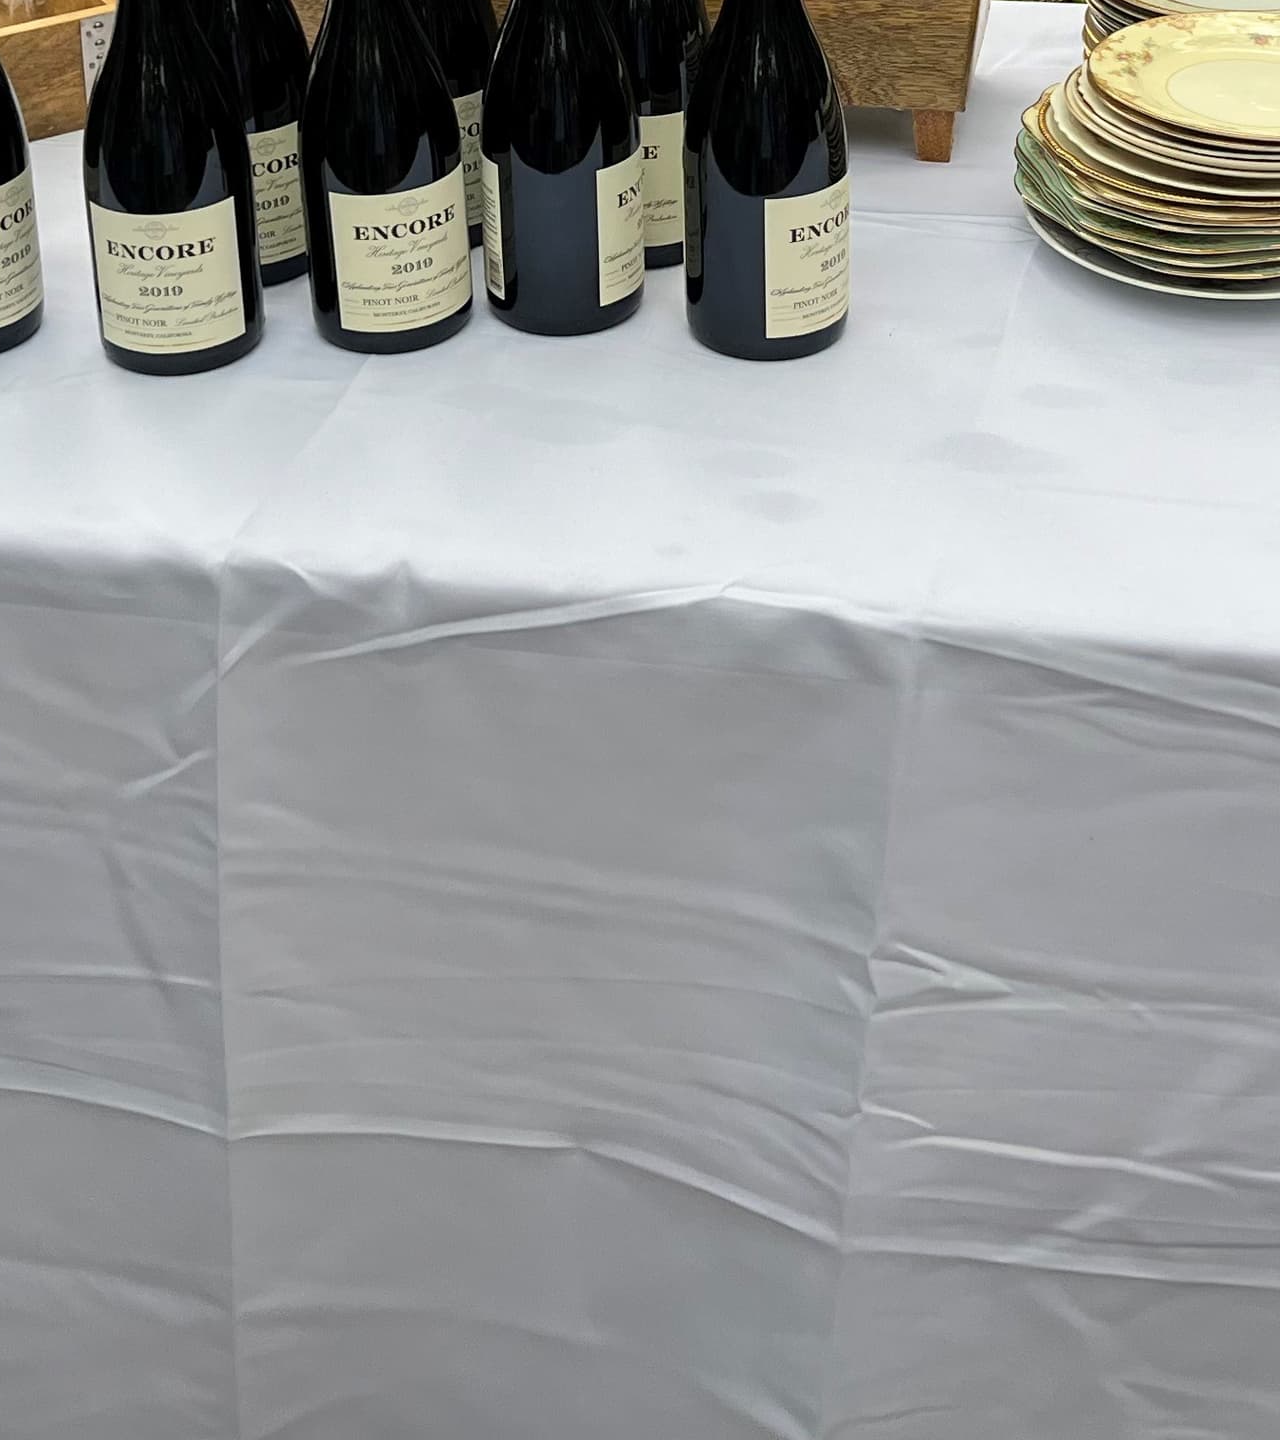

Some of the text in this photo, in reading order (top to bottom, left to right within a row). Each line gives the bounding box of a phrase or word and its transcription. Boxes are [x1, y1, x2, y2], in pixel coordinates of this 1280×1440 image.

[252, 153, 298, 177] COR
[352, 203, 455, 241] ENCORE
[789, 203, 849, 244] ENCO
[259, 230, 276, 239] OIR
[1, 244, 31, 269] 2019
[106, 237, 215, 261] ENCORE
[391, 257, 434, 275] 2019
[821, 248, 847, 273] 2019
[5, 283, 25, 298] NOIR
[138, 285, 184, 297] 2019
[362, 294, 420, 307] PINOT NOIR
[793, 297, 820, 310] PINOT
[116, 313, 167, 327] PINOT NOIR
